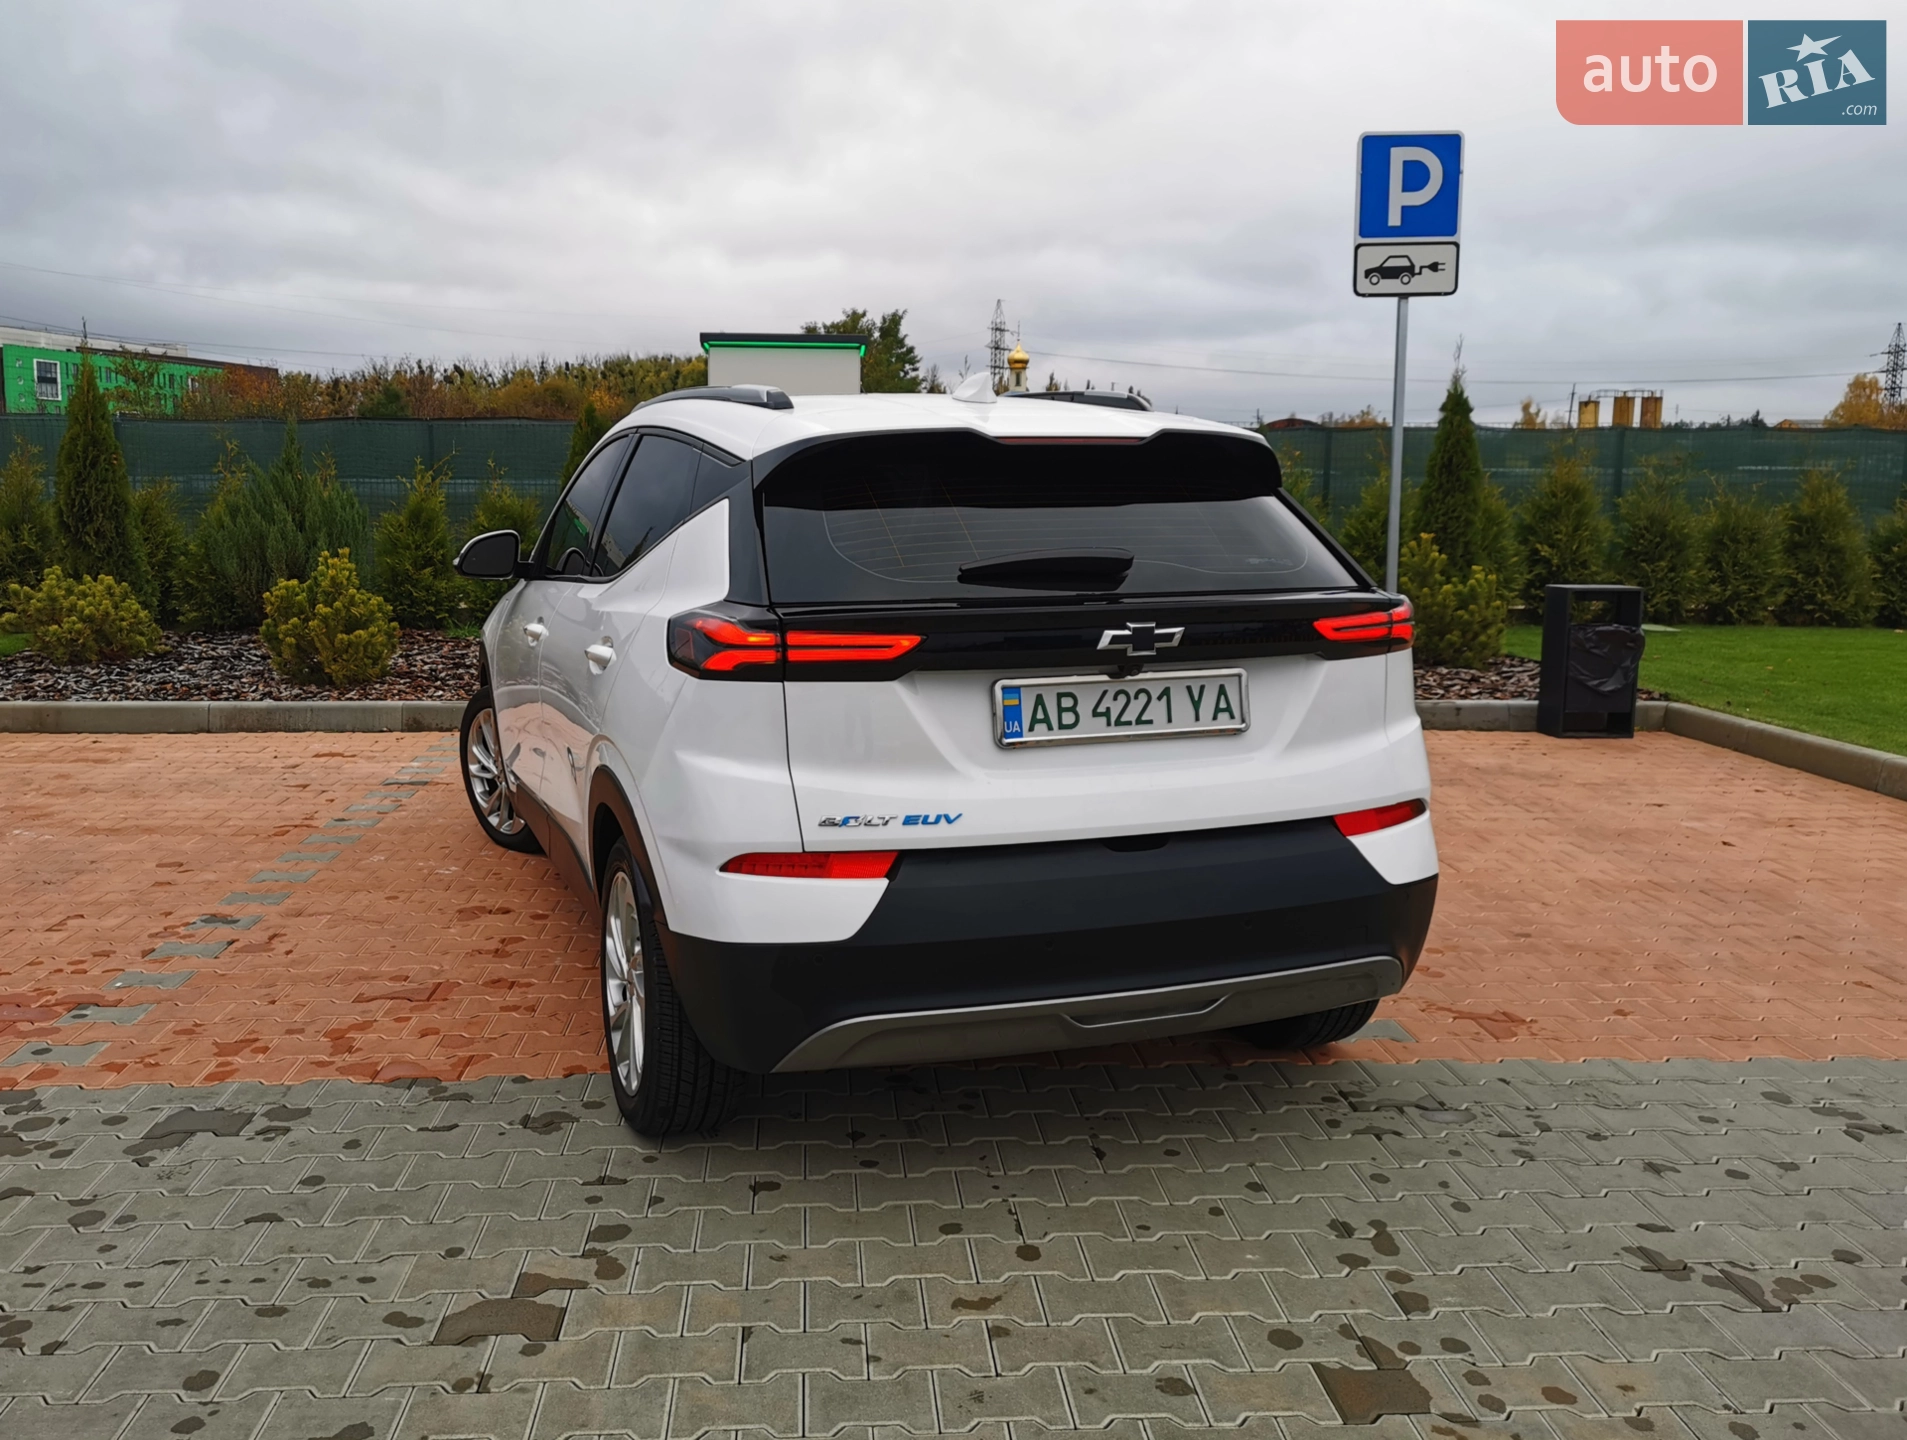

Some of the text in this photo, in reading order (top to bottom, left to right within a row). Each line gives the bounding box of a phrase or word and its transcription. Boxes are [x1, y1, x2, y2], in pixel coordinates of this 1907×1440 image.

[1387, 146, 1443, 227] P
[1028, 683, 1236, 732] AB 4221 YA
[1003, 720, 1021, 734] UA
[818, 812, 963, 828] BOLT EUV
